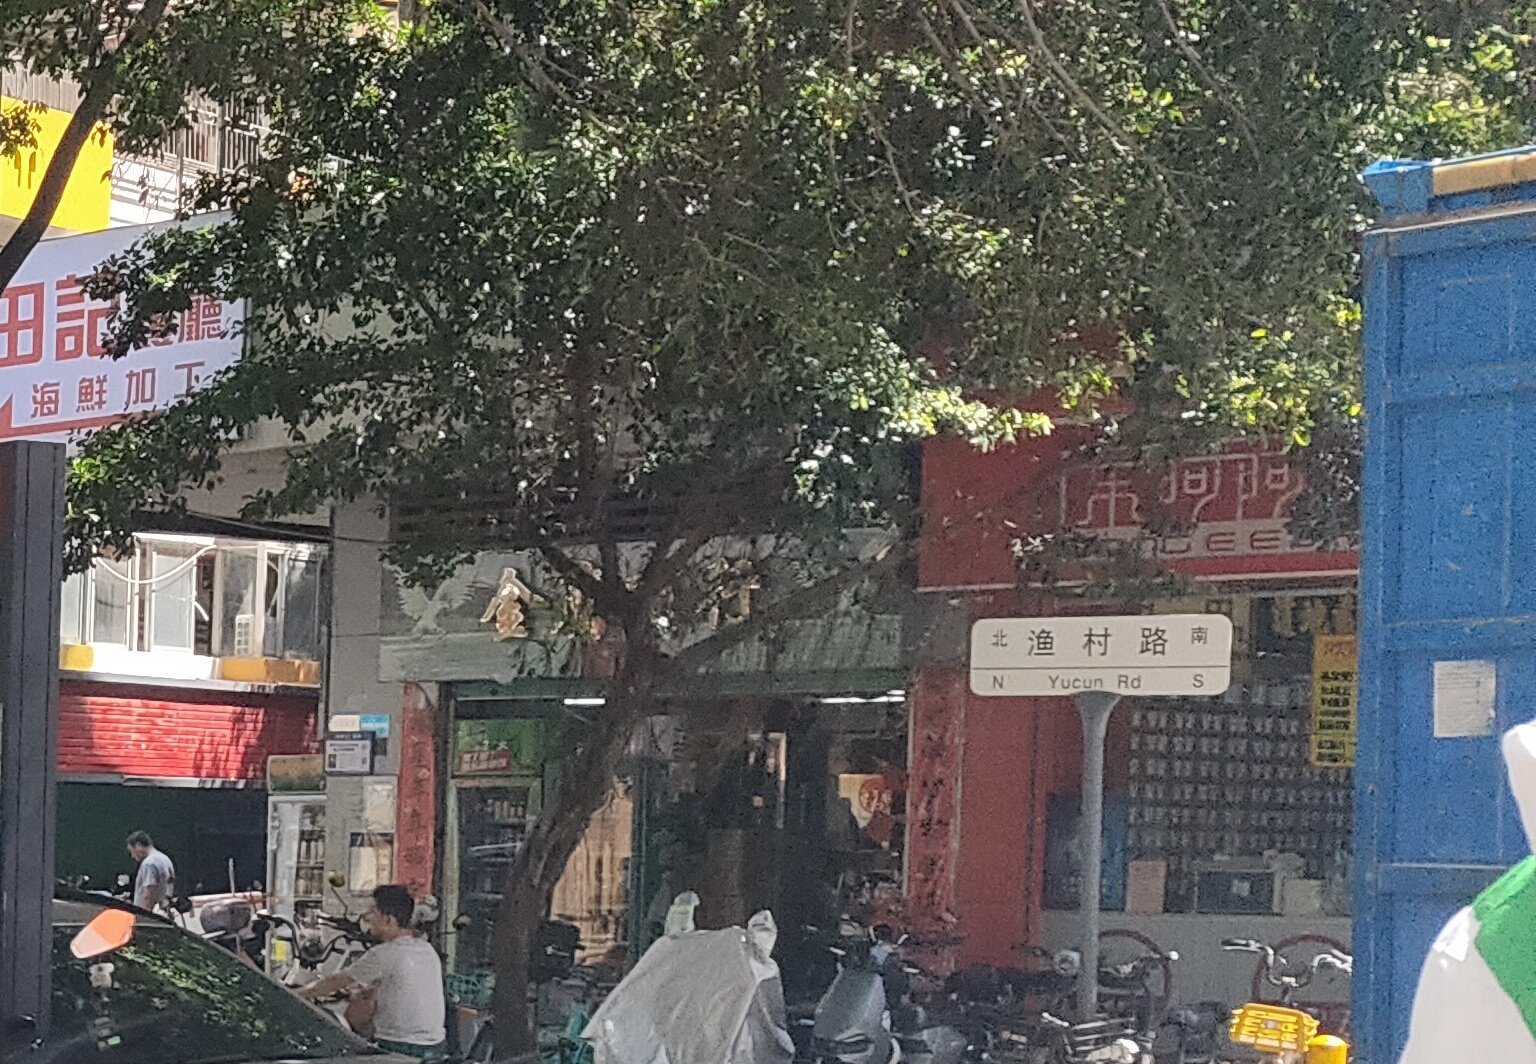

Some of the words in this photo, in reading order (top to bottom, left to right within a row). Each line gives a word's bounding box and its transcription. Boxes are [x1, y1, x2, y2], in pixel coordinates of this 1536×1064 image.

[991, 629, 1008, 648] 北
[1027, 626, 1169, 657] 渔村路
[1191, 626, 1209, 645] 南
[992, 676, 1004, 689] N
[1048, 675, 1103, 689] Yucun
[1118, 675, 1141, 689] Rd
[1192, 674, 1205, 688] S
